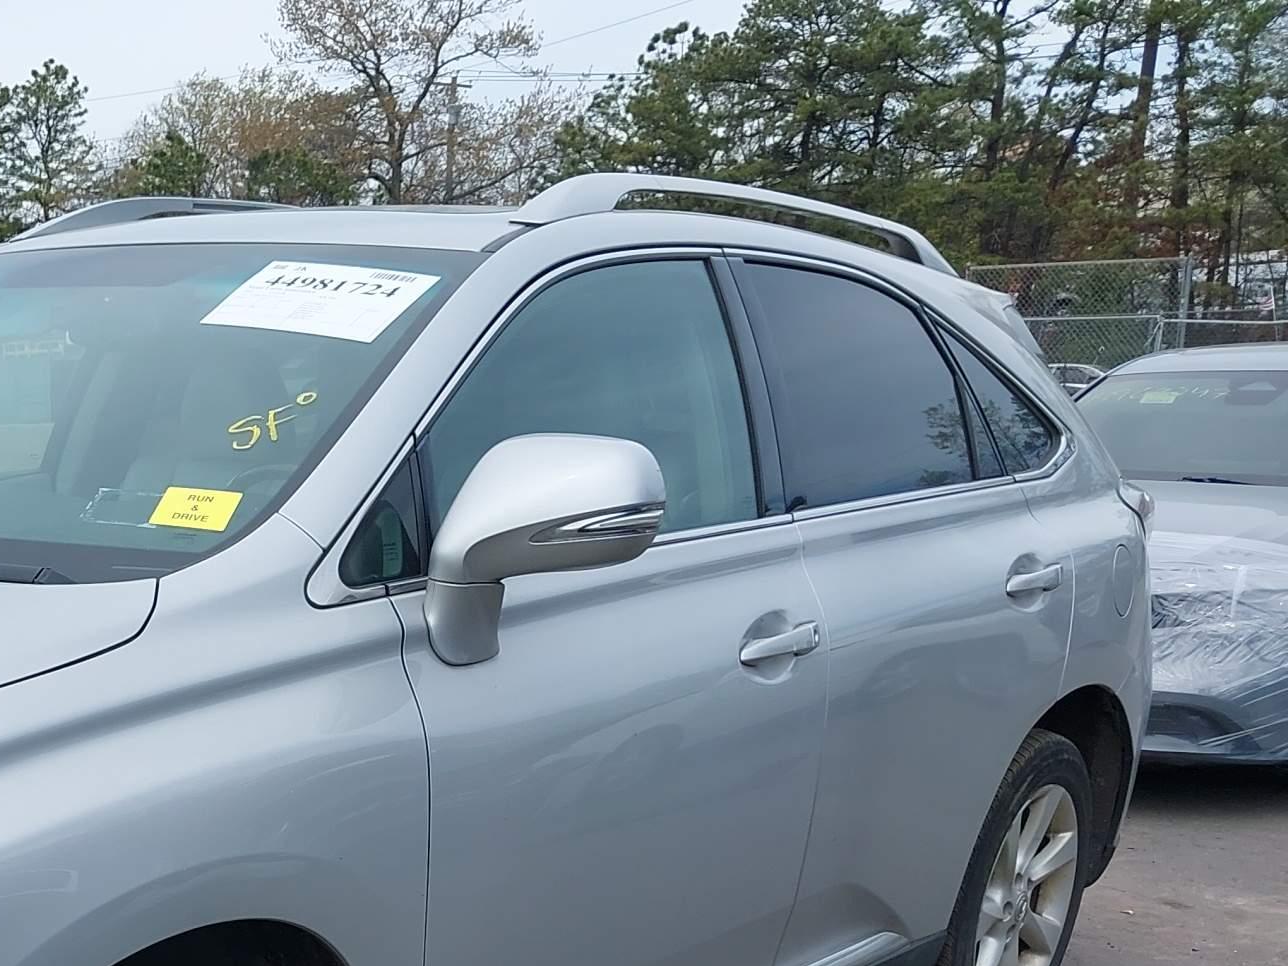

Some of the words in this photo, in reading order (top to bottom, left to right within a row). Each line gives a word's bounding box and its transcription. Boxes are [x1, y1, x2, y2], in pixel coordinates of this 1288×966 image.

[265, 274, 401, 297] 44981724
[187, 494, 215, 503] RUN
[190, 504, 200, 512] &
[171, 512, 209, 523] DRIVE
